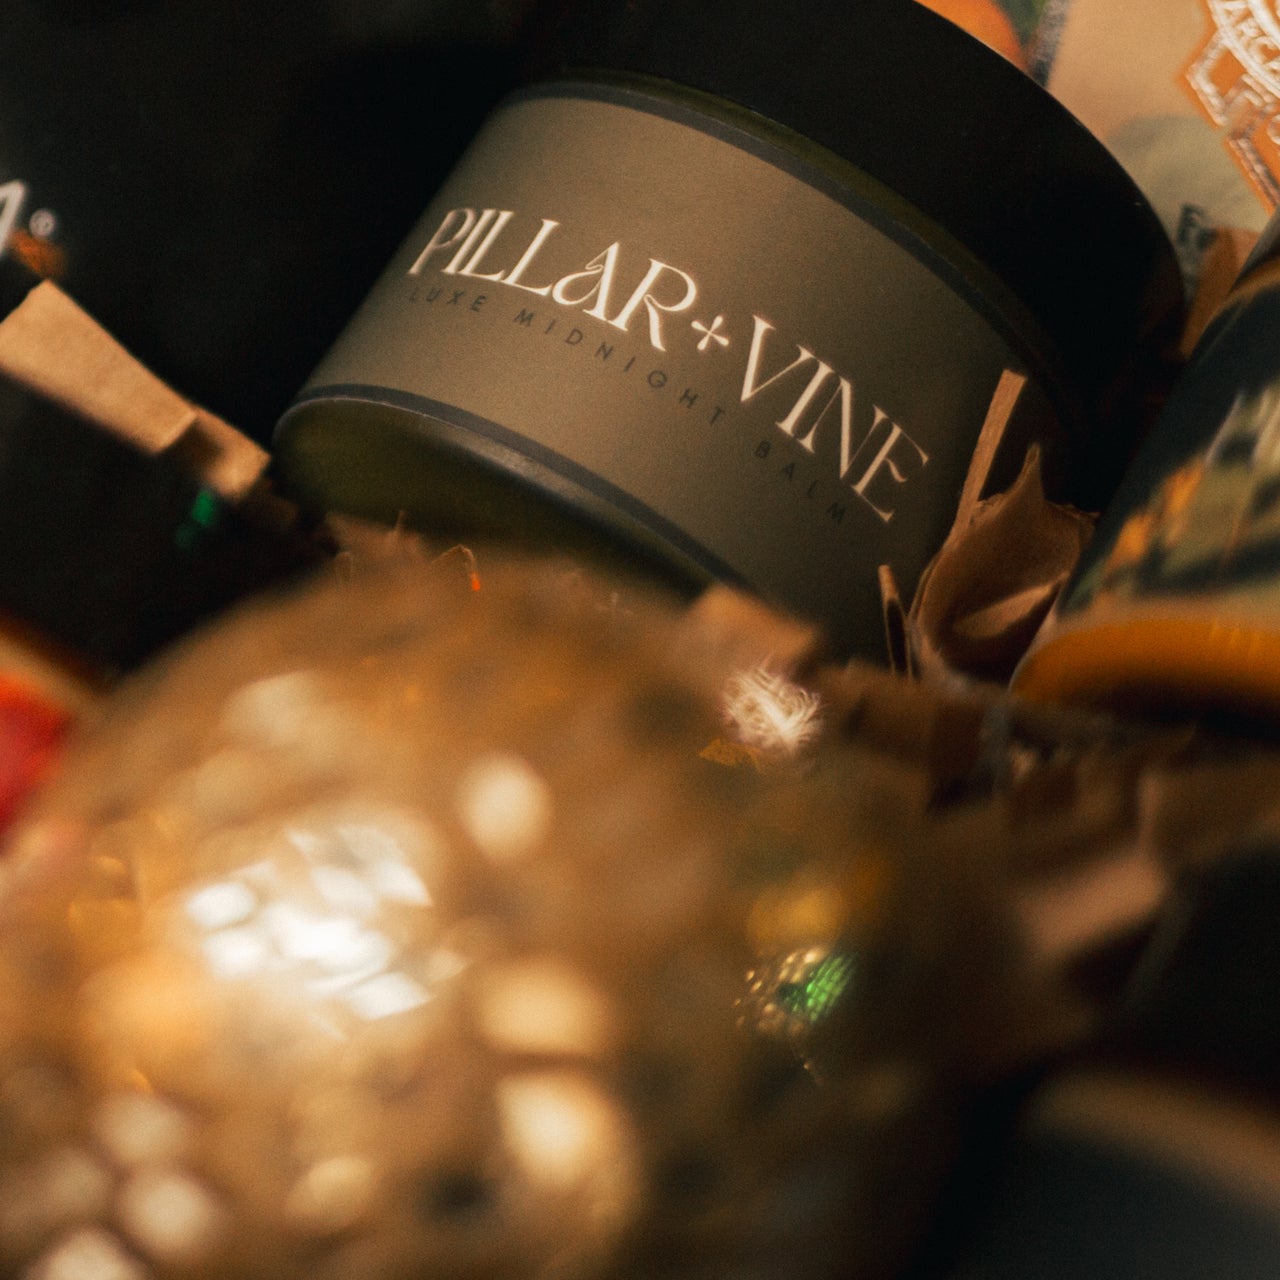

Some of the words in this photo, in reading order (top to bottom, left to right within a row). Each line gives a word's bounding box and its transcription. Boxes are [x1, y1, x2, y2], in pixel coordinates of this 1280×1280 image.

[408, 285, 489, 314] LUXE
[512, 306, 728, 427] MIDNIGHT
[752, 438, 847, 524] BALM
